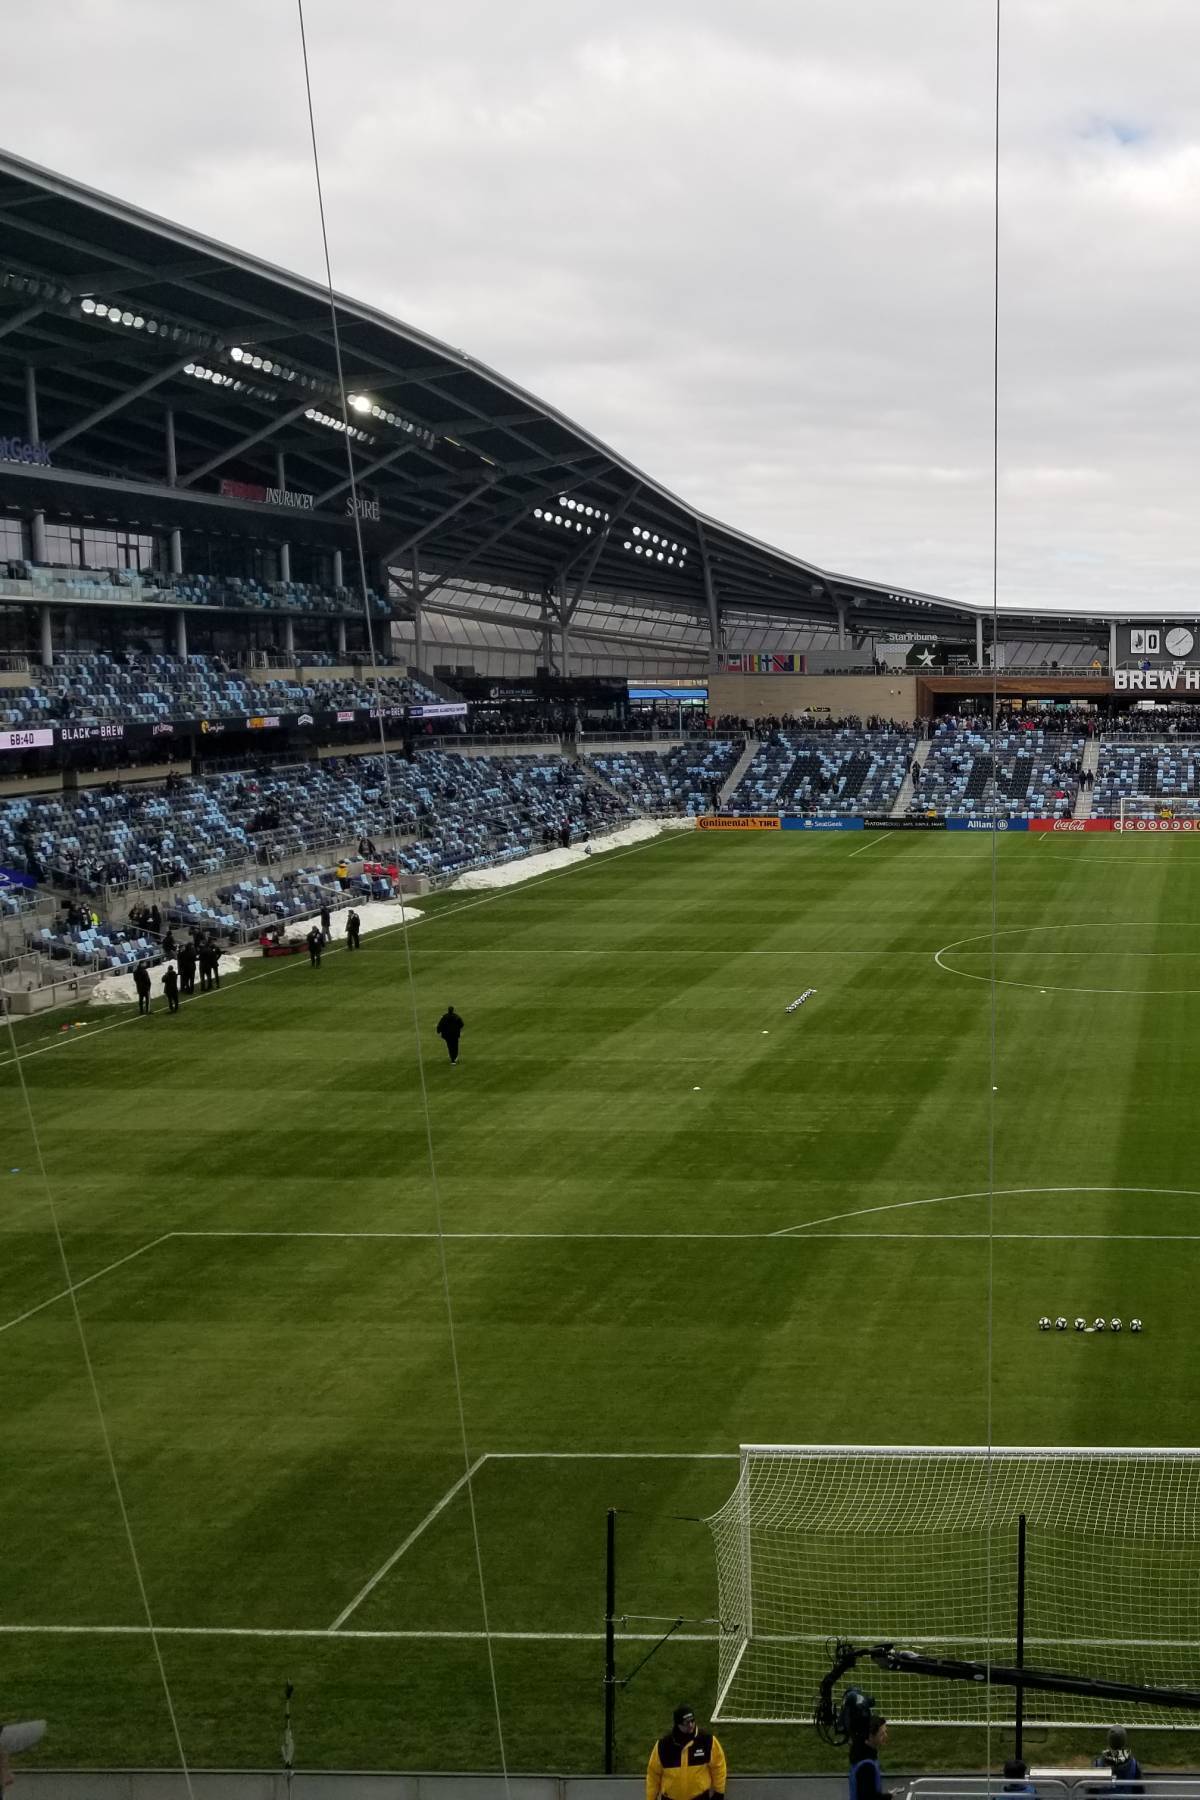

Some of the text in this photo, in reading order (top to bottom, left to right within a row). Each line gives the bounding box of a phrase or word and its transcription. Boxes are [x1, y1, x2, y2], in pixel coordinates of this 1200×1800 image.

[345, 496, 380, 522] SPIRE
[1114, 670, 1178, 690] BREW
[62, 728, 90, 740] BLACK
[101, 725, 124, 737] BREW
[700, 818, 749, 828] Continental
